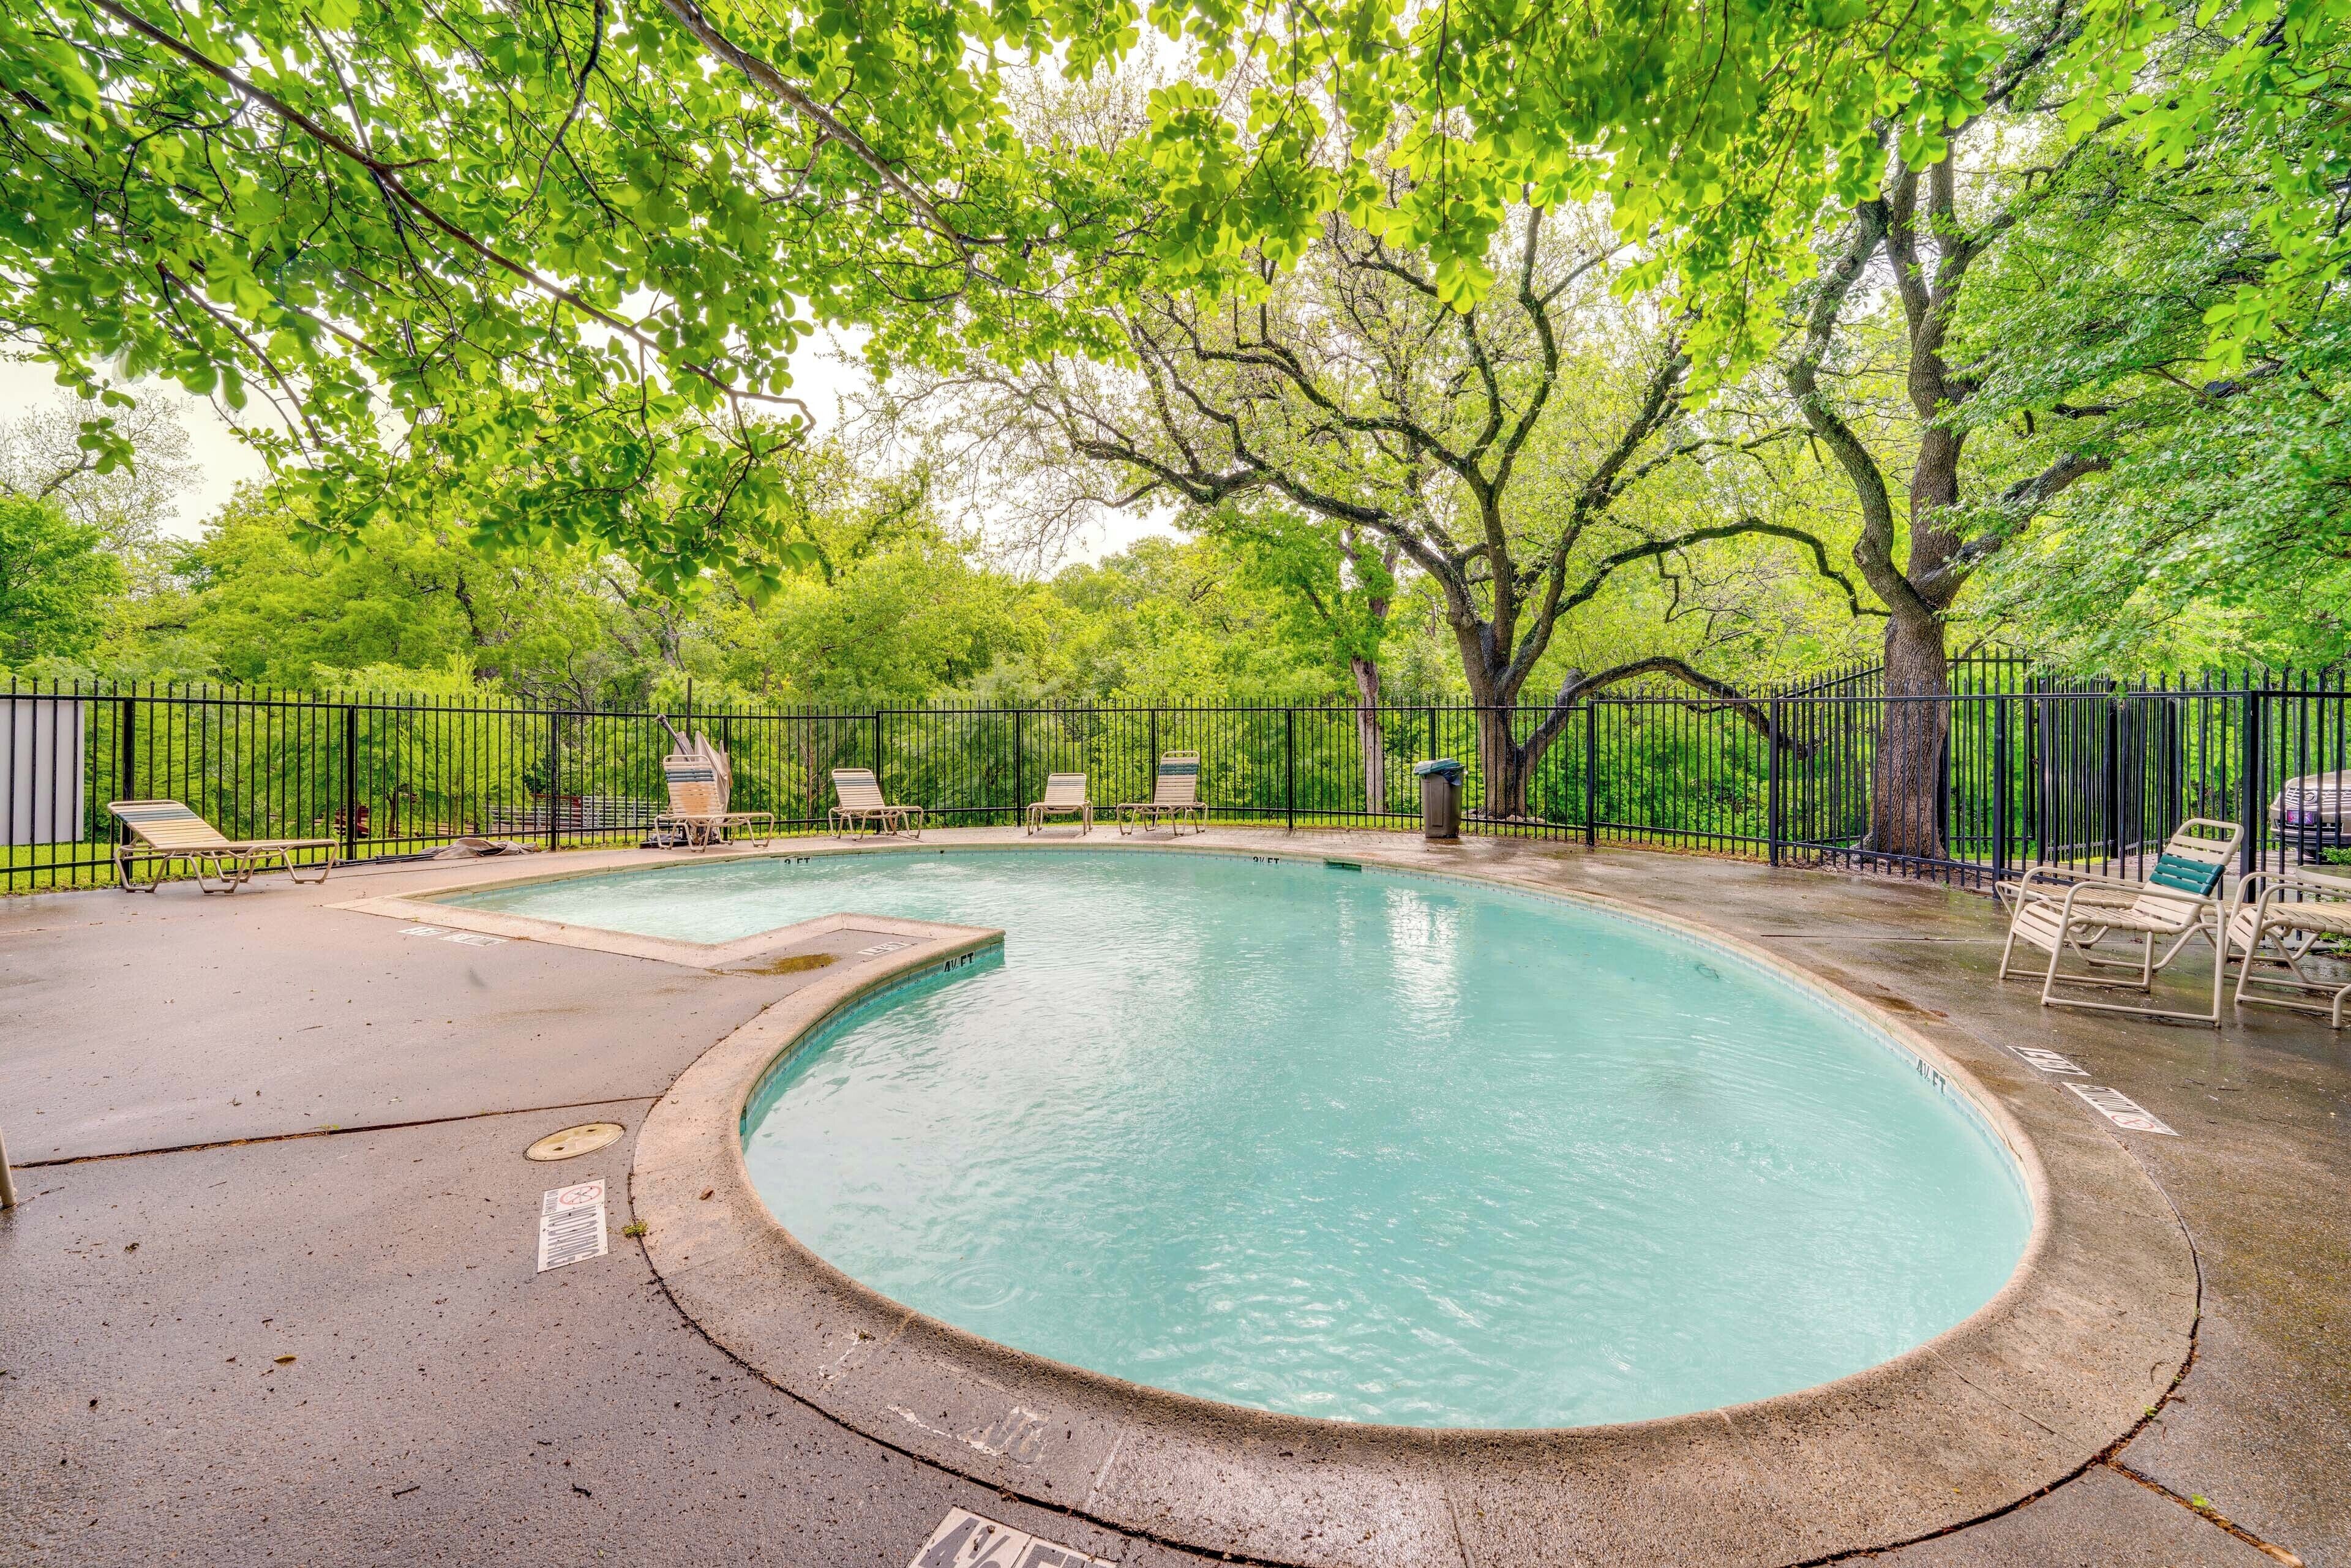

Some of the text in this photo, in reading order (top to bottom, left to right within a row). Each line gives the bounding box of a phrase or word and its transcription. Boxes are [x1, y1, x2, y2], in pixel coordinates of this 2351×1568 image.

[961, 952, 974, 967] FT
[2011, 1047, 2066, 1061] FT
[1933, 1070, 1946, 1095] FT
[2070, 1084, 2135, 1107] DIVING
[544, 1197, 558, 1214] DIVING
[547, 1206, 599, 1267] NO DIVING
